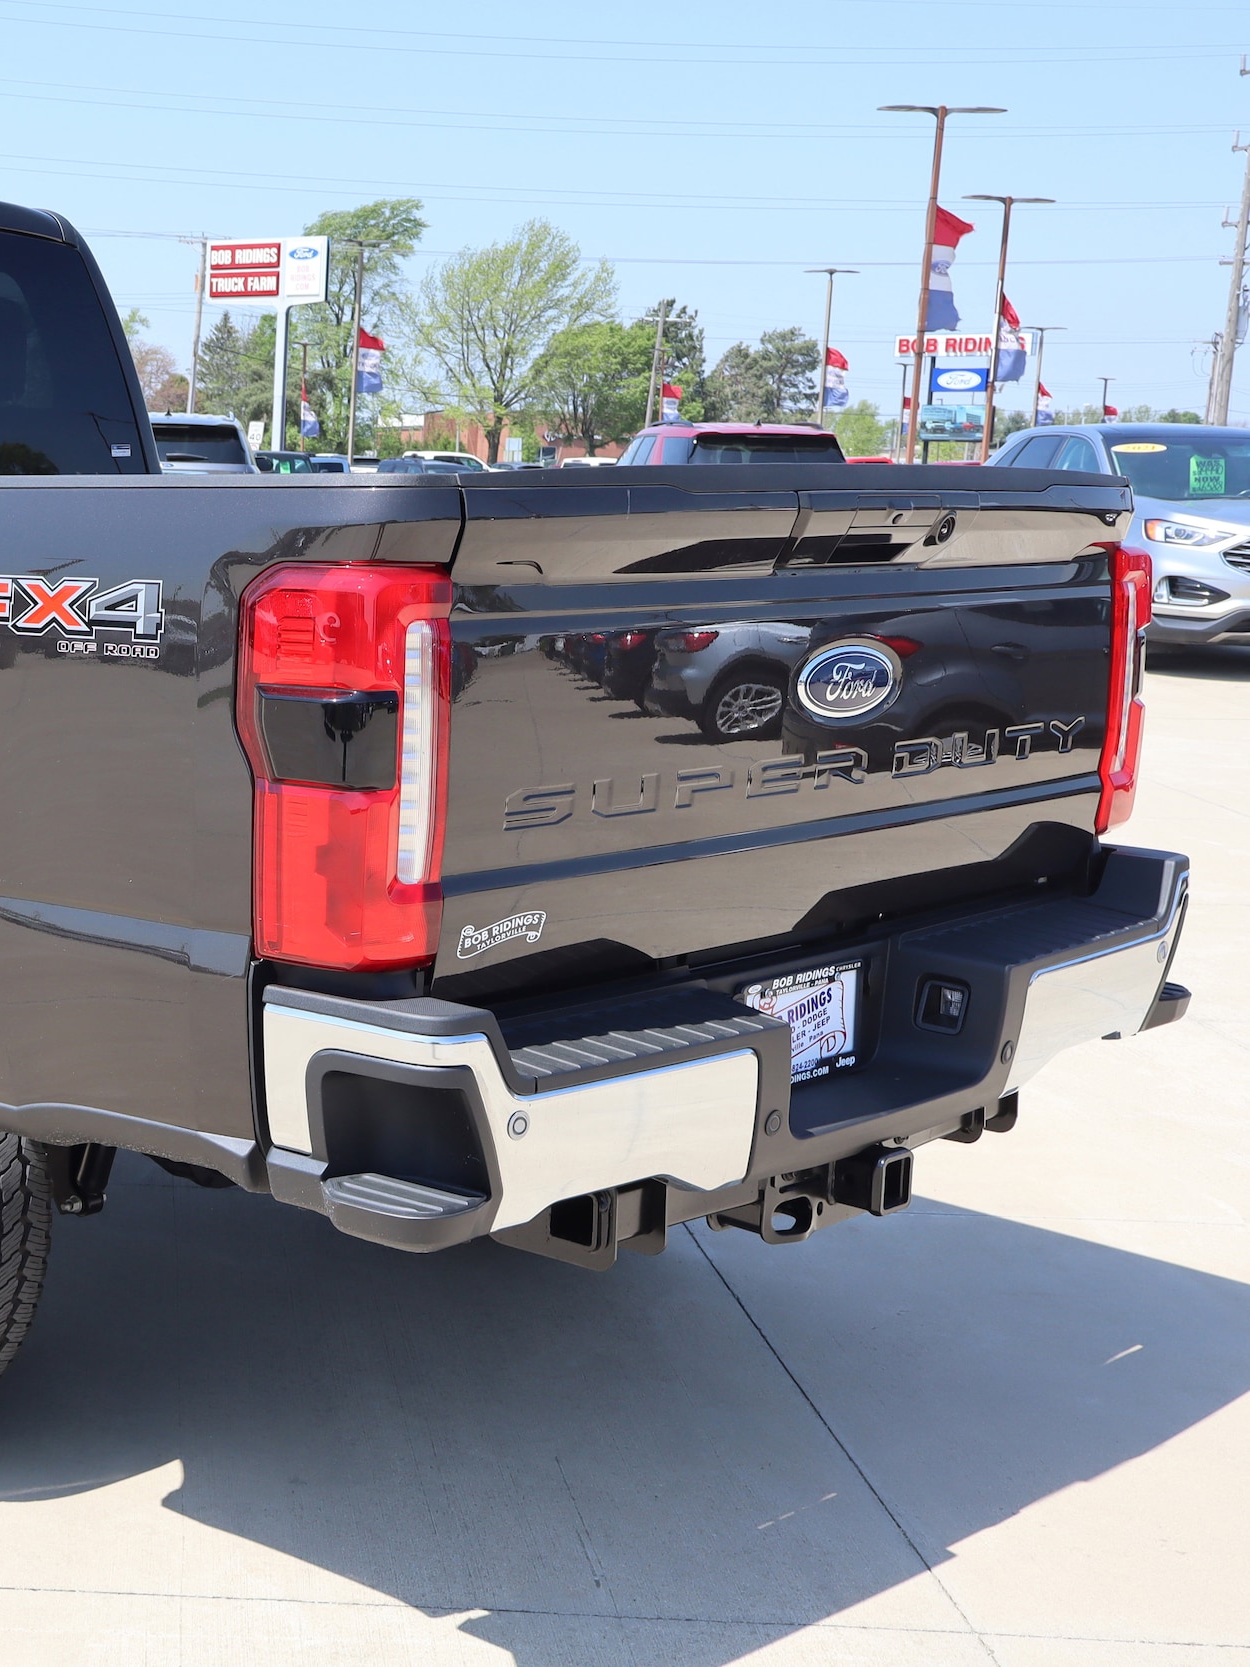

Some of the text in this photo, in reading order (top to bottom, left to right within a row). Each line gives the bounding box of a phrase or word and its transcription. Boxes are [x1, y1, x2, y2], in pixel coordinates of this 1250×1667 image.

[211, 247, 278, 265] BOB RIDINGS
[293, 247, 315, 259] Ford
[211, 276, 277, 292] TRUCK FARM
[946, 374, 972, 386] Ford
[250, 433, 261, 441] 40
[57, 640, 160, 659] OFF ROAD
[826, 662, 878, 702] Ford
[502, 716, 1086, 832] SUPER DUTY
[464, 914, 540, 949] BOB RIDINGS
[476, 925, 527, 950] TAYLORVILLE
[772, 961, 862, 990] BOB RIDINGS CHRYSLER
[776, 983, 810, 996] TAYLORVILLE
[815, 977, 829, 986] PANA
[787, 987, 833, 1025] RIDINGS
[802, 1008, 828, 1028] DODGE
[812, 1016, 831, 1031] JEEP
[809, 1030, 823, 1042] Pana
[835, 1056, 856, 1068] Jeep
